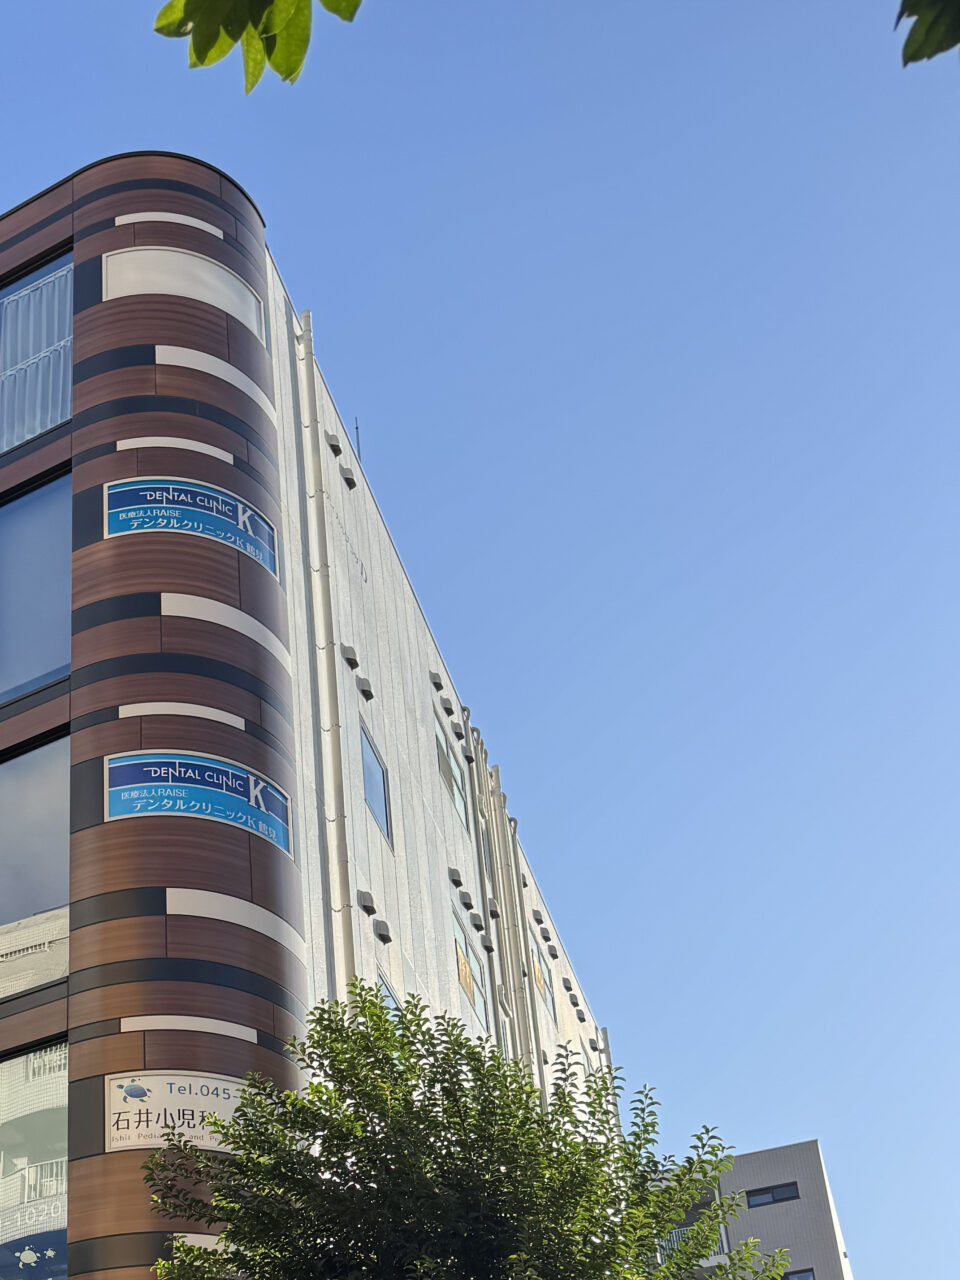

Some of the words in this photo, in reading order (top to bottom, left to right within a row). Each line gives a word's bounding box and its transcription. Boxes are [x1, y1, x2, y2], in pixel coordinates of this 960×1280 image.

[119, 508, 182, 520] 医療法人RAISE
[139, 486, 193, 506] DENTAL
[196, 495, 233, 516] CLINIC
[236, 501, 257, 539] K
[121, 788, 189, 800] 医療法人RAISE
[143, 760, 201, 784] DENTAL
[204, 770, 244, 792] CLINIC
[247, 774, 270, 814] K
[166, 1082, 240, 1100] Tel.045-
